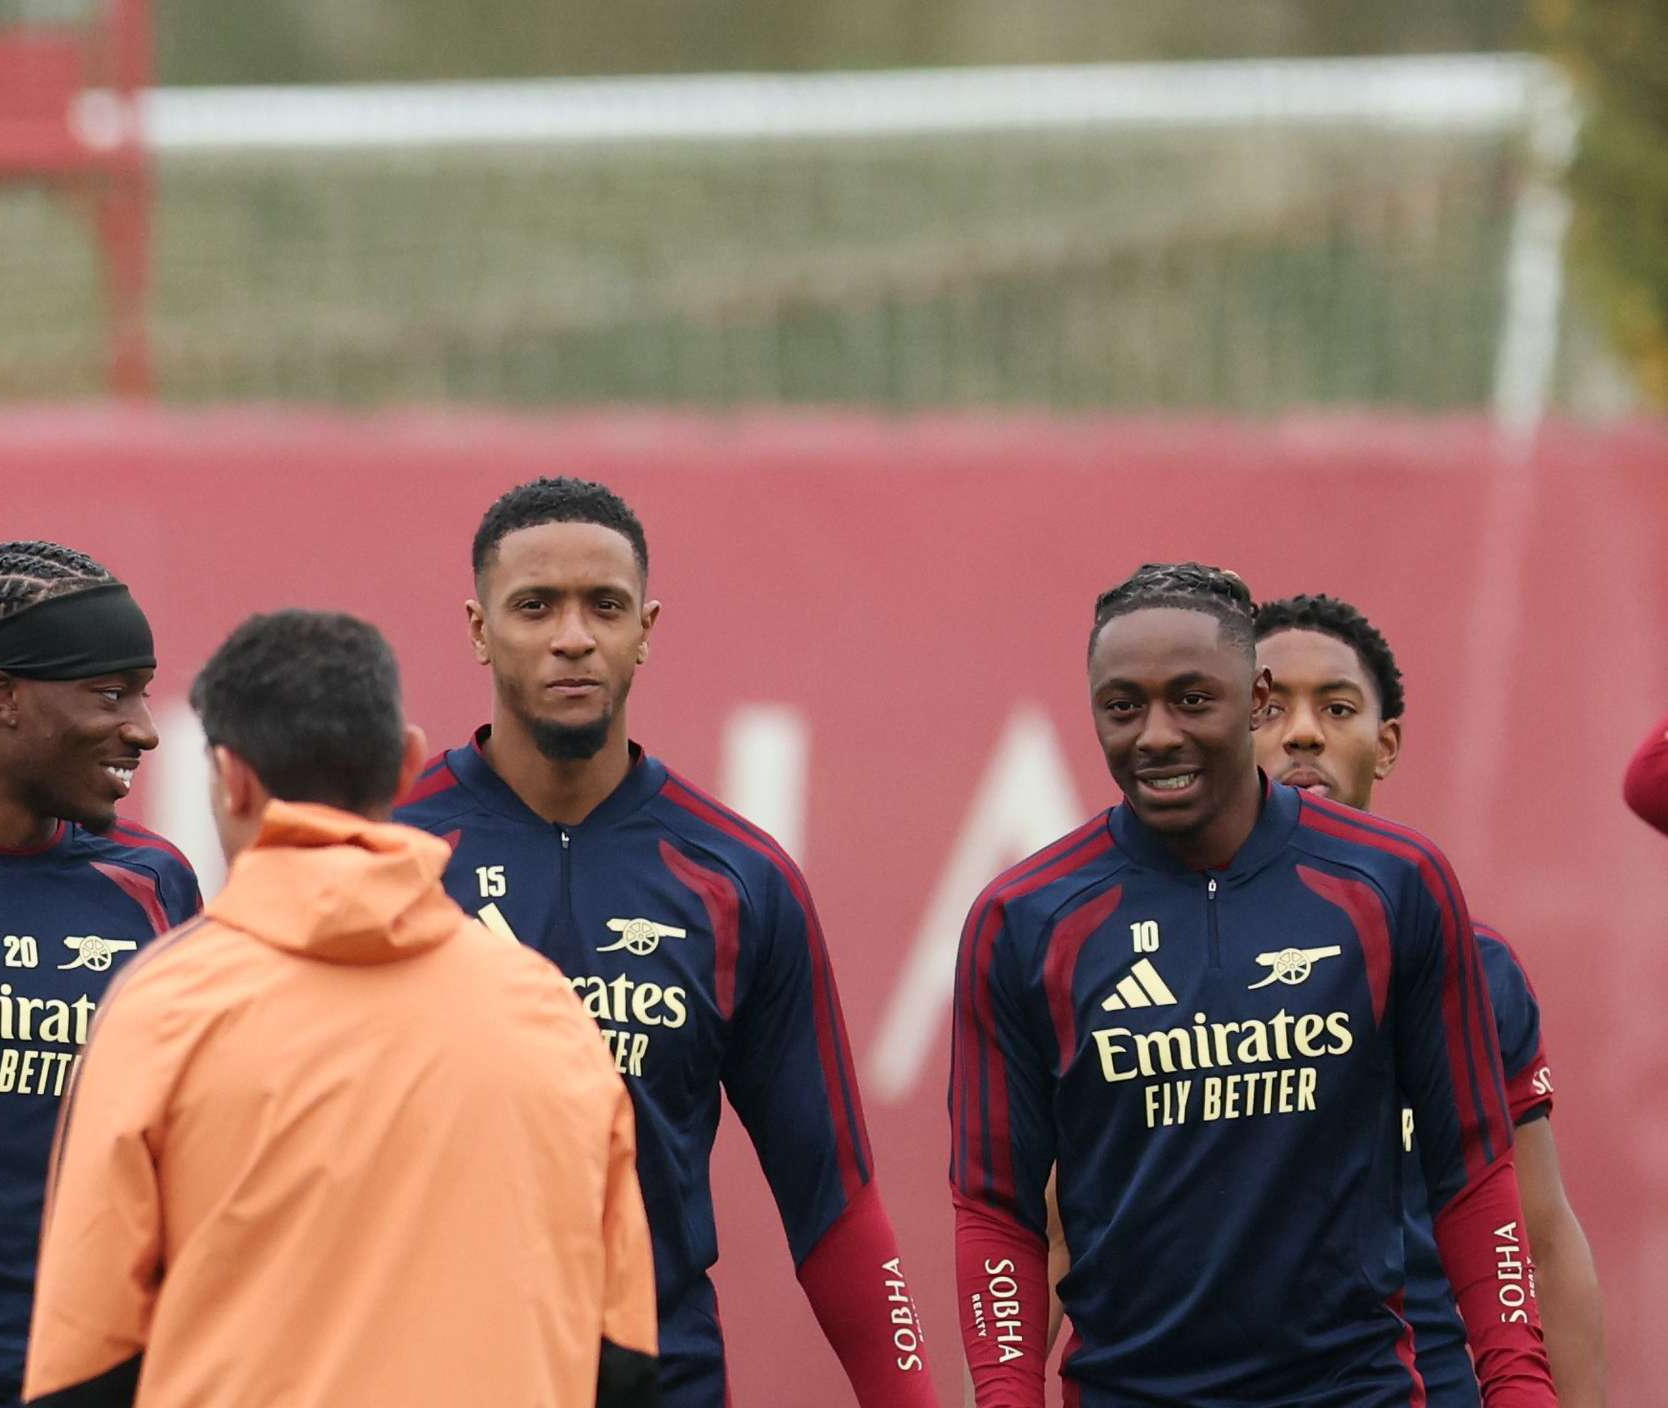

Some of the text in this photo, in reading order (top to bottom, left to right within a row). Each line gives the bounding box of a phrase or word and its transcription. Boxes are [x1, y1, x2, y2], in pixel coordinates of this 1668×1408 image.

[475, 865, 506, 898] 15
[3, 935, 39, 968] 20
[1130, 920, 1160, 953] 10
[600, 1029, 649, 1077] TER
[1091, 1008, 1353, 1083] Emirates
[1145, 1067, 1316, 1128] FLY BETTER
[882, 1257, 922, 1371] SOBHA
[972, 1293, 986, 1337] REALTY
[985, 1258, 1024, 1362] SOBHA
